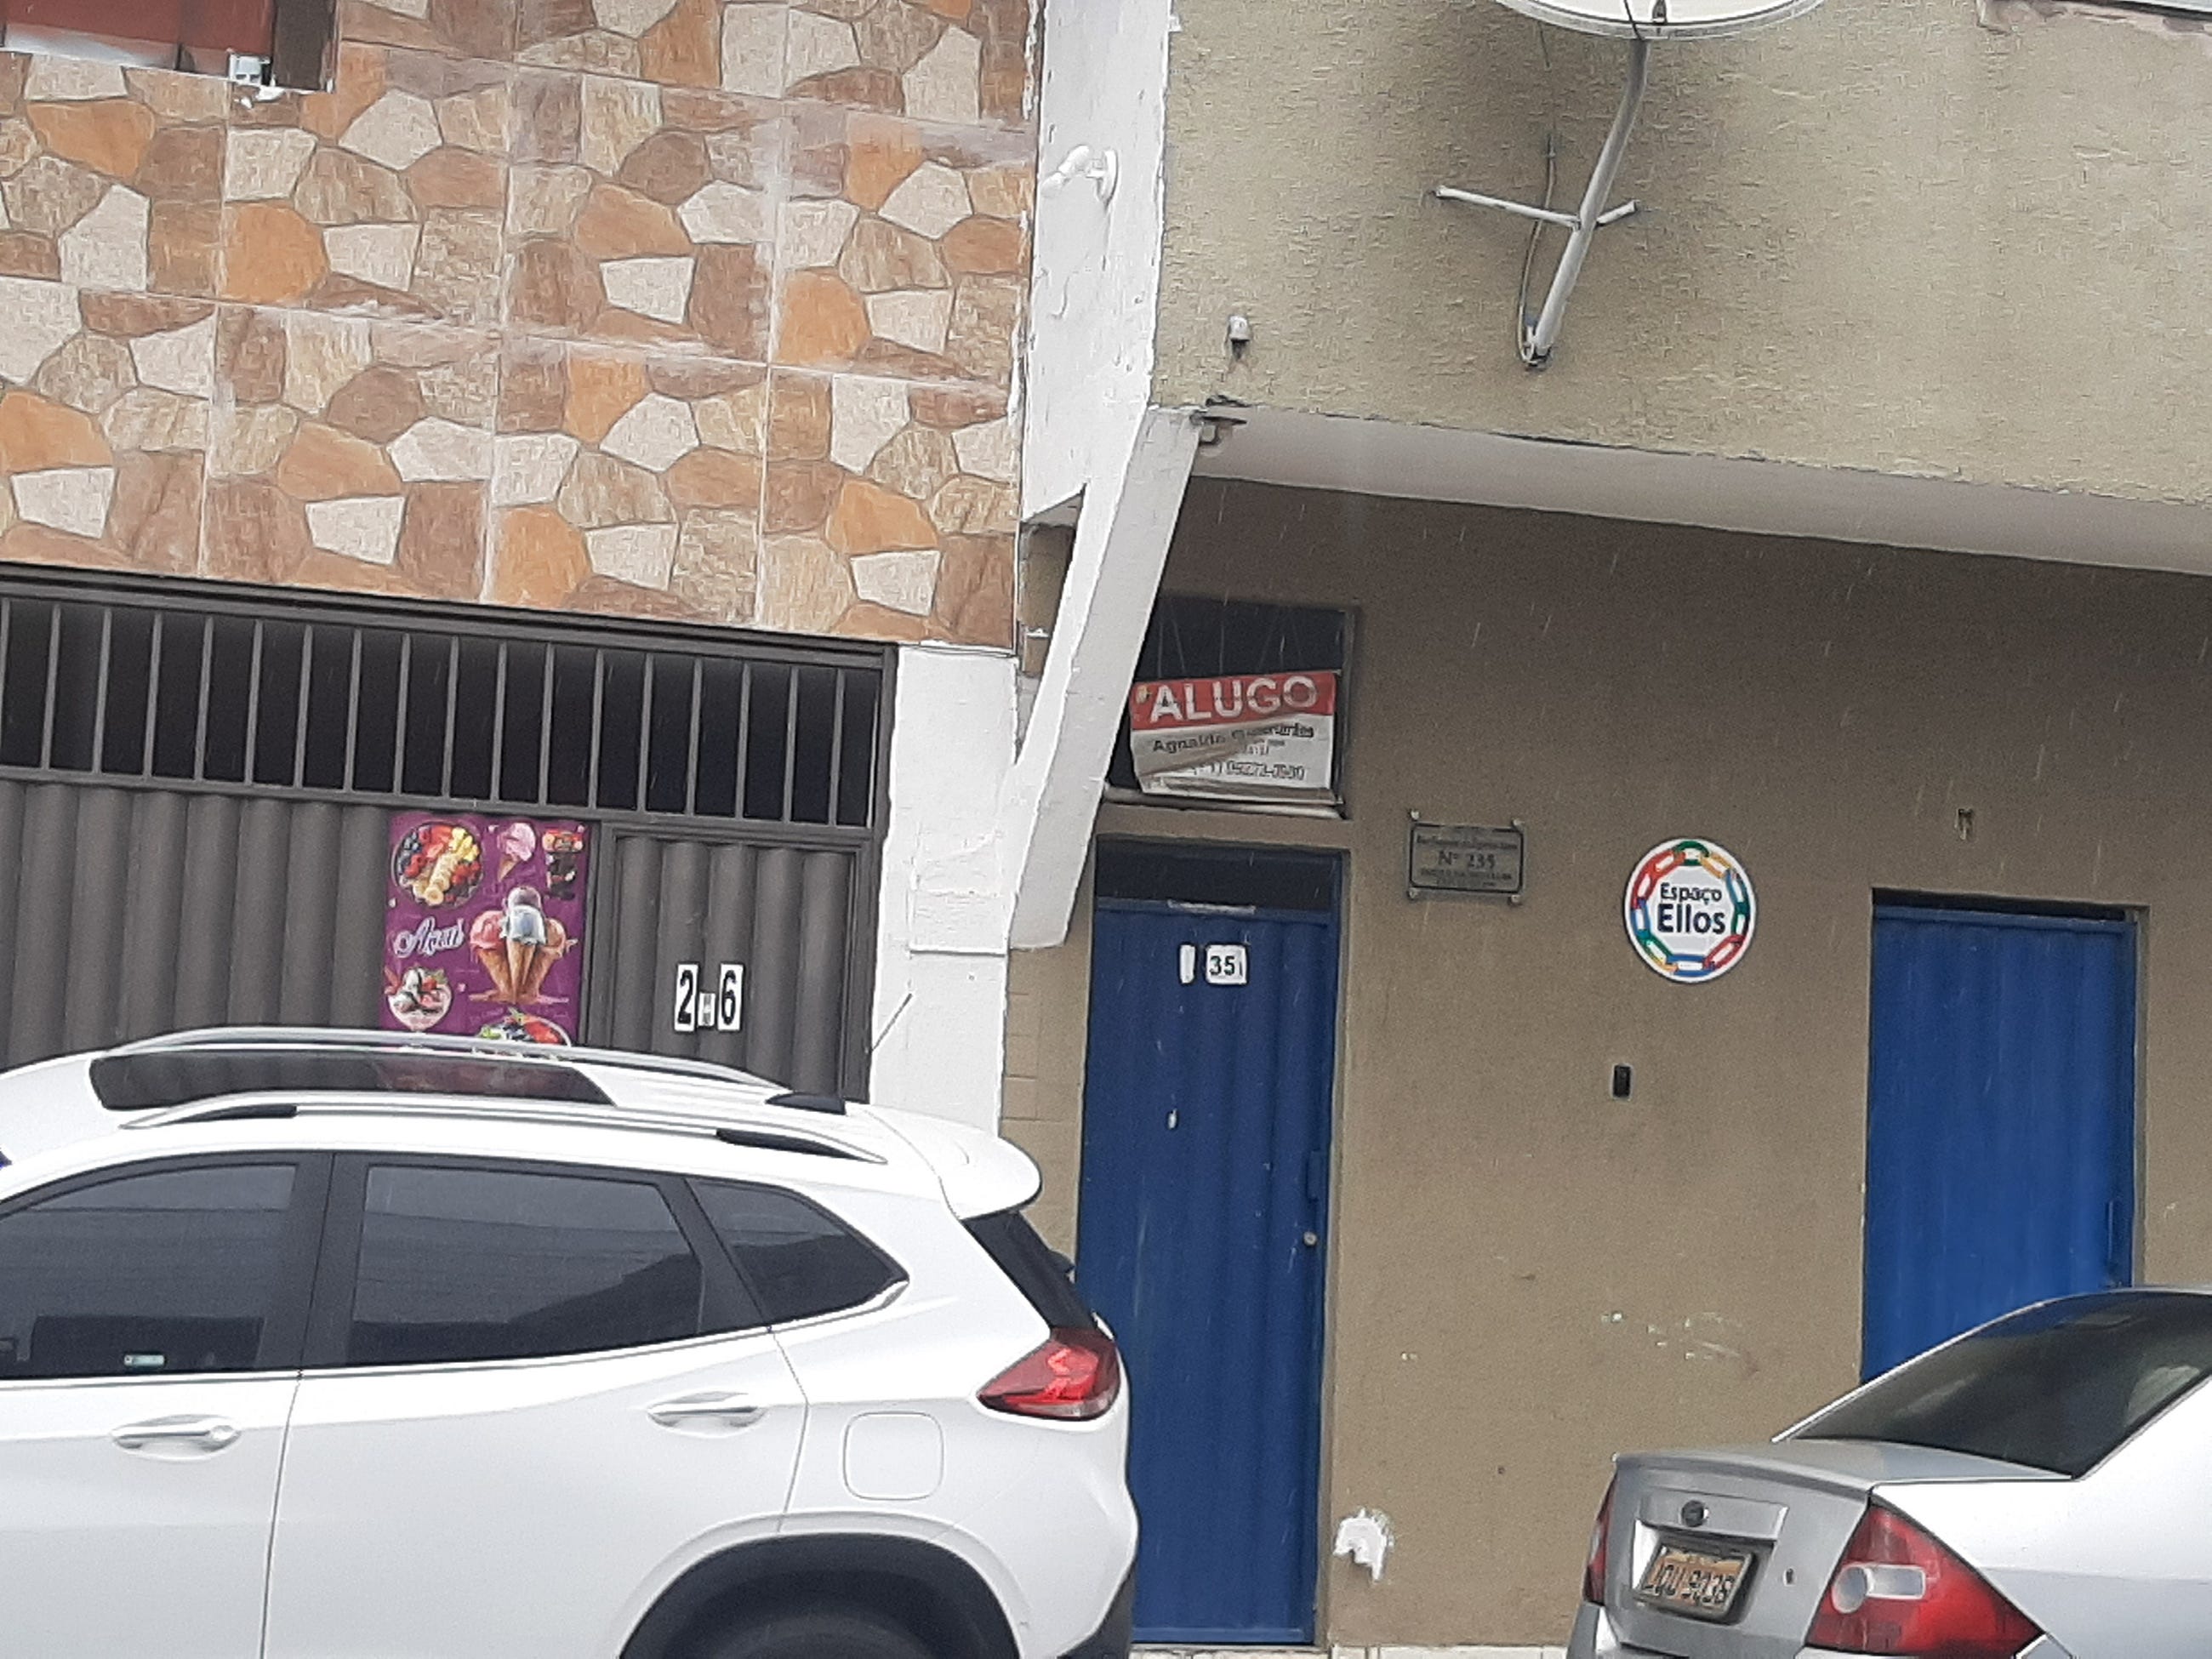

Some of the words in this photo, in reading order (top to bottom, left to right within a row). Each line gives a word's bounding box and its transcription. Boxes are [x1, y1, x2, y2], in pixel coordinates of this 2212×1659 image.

[1150, 676, 1317, 723] ALUGO
[1660, 882, 1723, 904] Espaço
[1658, 904, 1726, 935] Ellos
